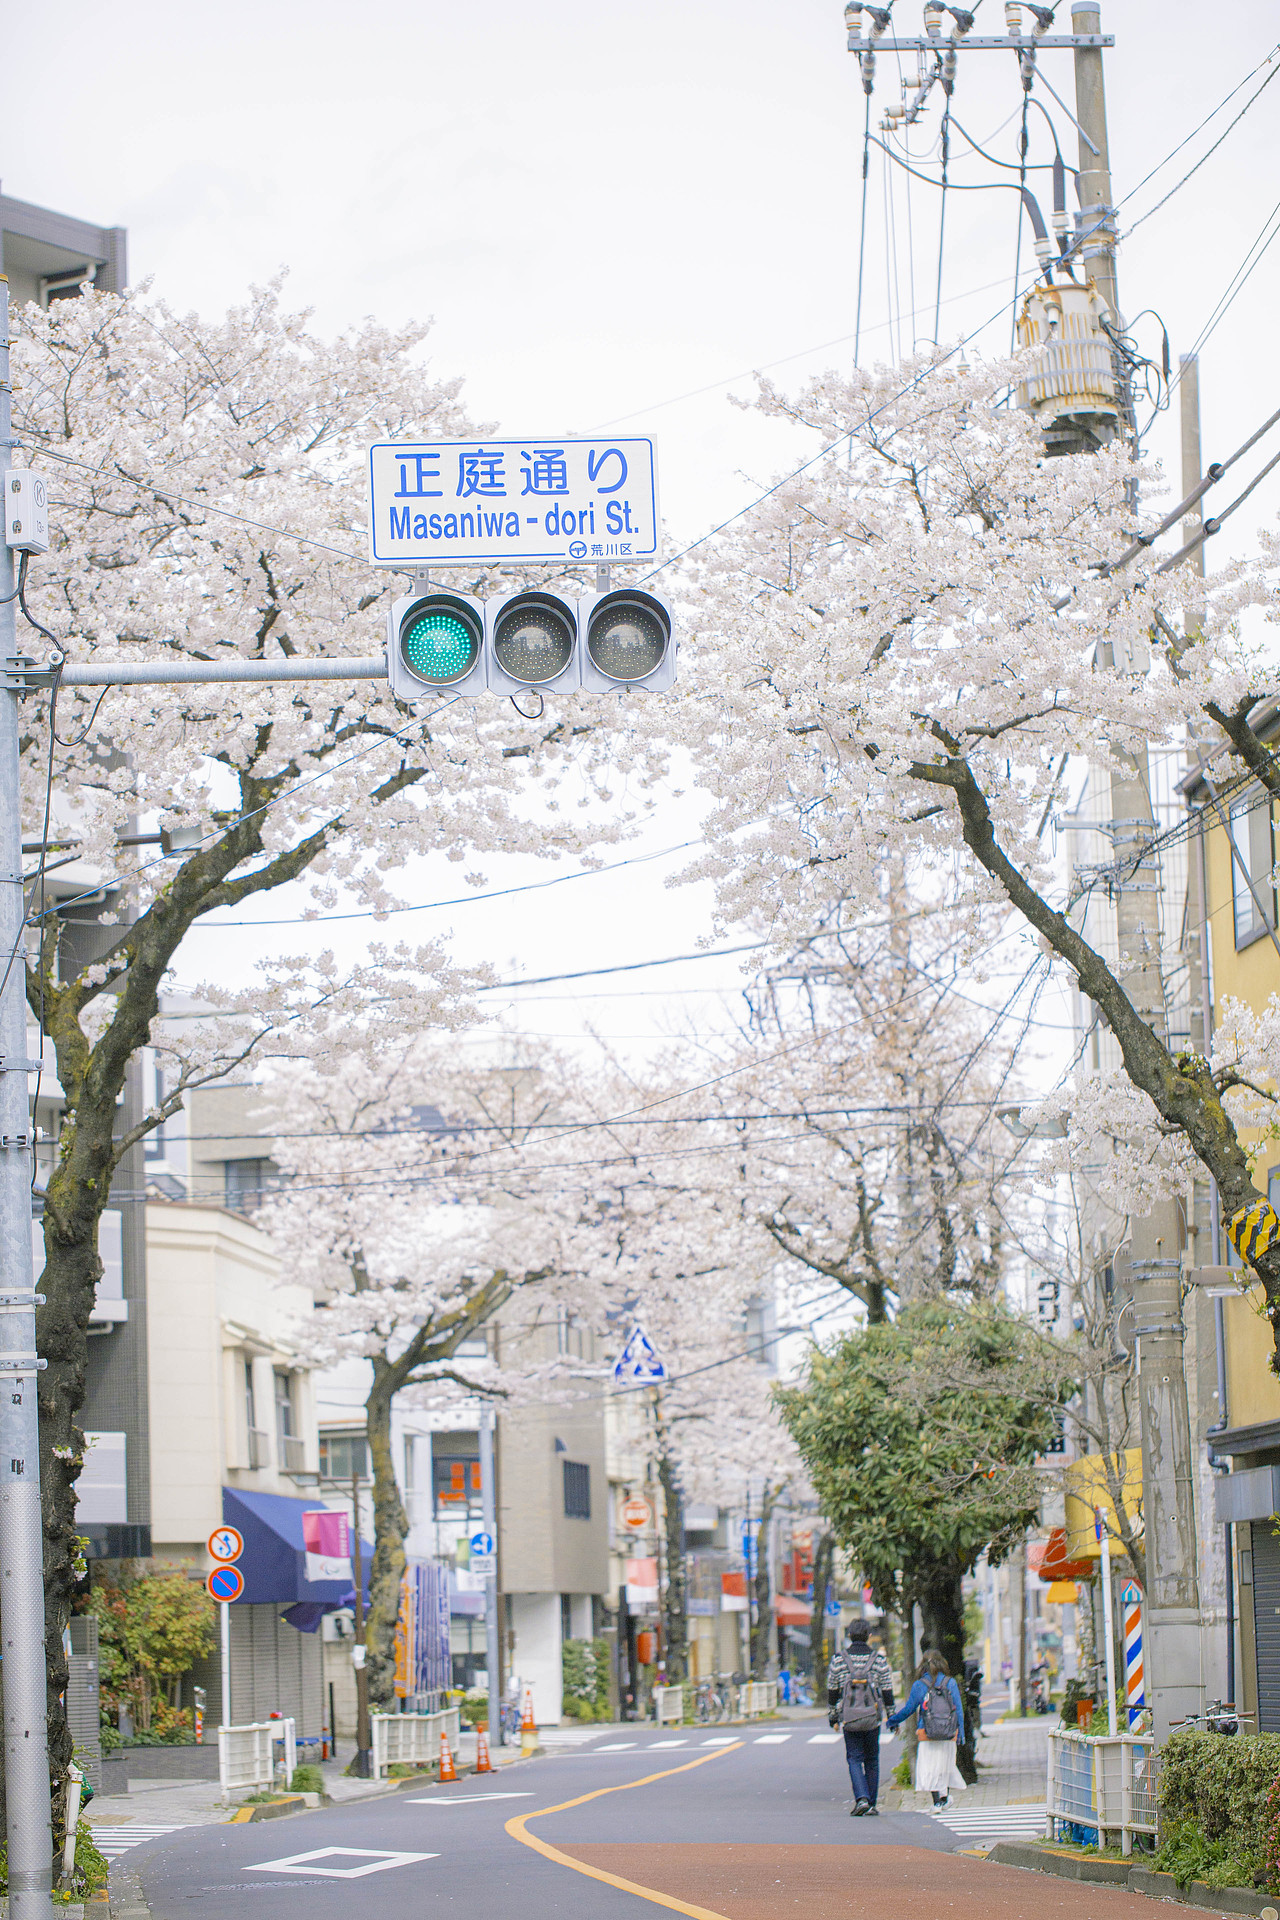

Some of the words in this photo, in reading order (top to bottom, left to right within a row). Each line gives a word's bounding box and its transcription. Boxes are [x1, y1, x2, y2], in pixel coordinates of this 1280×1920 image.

[394, 447, 629, 499] 正庭通り
[605, 500, 639, 536] St.
[590, 543, 633, 556] 荒川区
